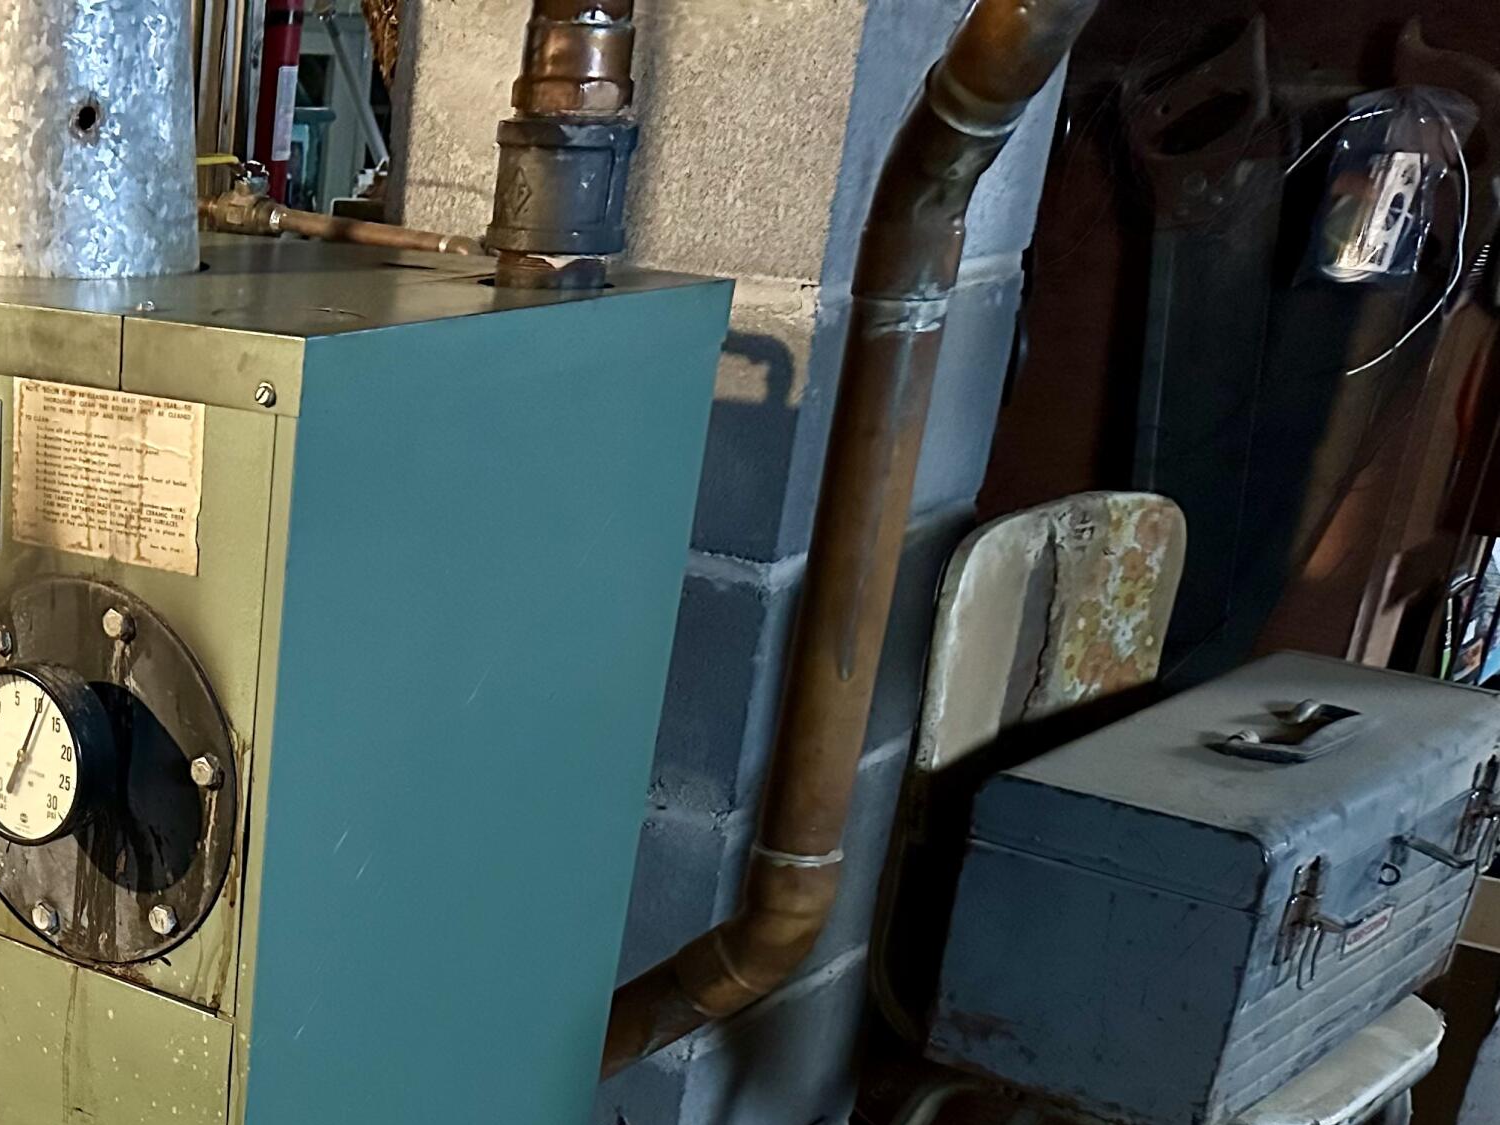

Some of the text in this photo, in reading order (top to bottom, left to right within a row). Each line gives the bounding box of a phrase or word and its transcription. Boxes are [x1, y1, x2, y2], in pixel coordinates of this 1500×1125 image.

[14, 690, 20, 706] 5
[34, 696, 43, 714] 10
[51, 716, 61, 733] 15
[60, 744, 72, 762] 20
[59, 773, 71, 791] 25
[46, 793, 58, 811] 30
